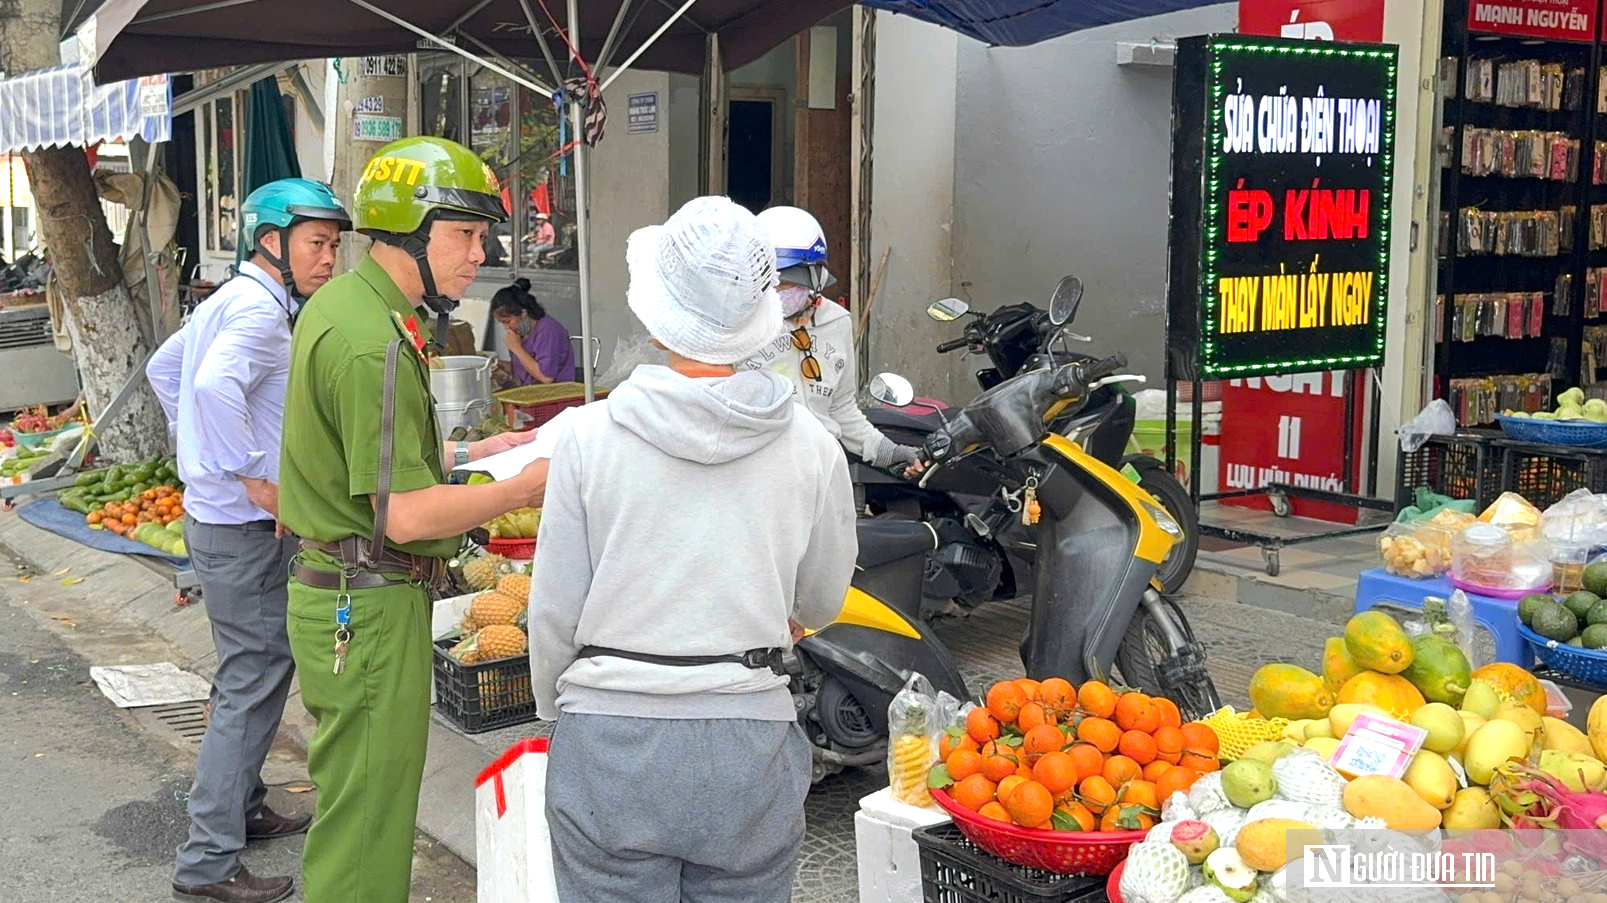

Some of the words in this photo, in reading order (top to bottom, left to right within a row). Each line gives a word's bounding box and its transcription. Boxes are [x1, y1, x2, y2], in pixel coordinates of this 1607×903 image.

[1475, 4, 1523, 27] MẠNH
[1527, 7, 1588, 31] NGUYỄN
[1223, 77, 1254, 153] SỬA
[1258, 85, 1298, 153] CHỮA
[1301, 85, 1335, 167] ĐIỆN
[1338, 98, 1381, 167] THOẠI
[364, 156, 427, 186] CSTT
[1227, 177, 1274, 243] ÉP
[1284, 177, 1371, 241] KÍNH
[1219, 275, 1260, 335] THAY
[1261, 262, 1298, 331] MÀN
[1299, 253, 1330, 329] LẤY
[1331, 271, 1374, 327] NGAY
[1278, 414, 1302, 460] 11
